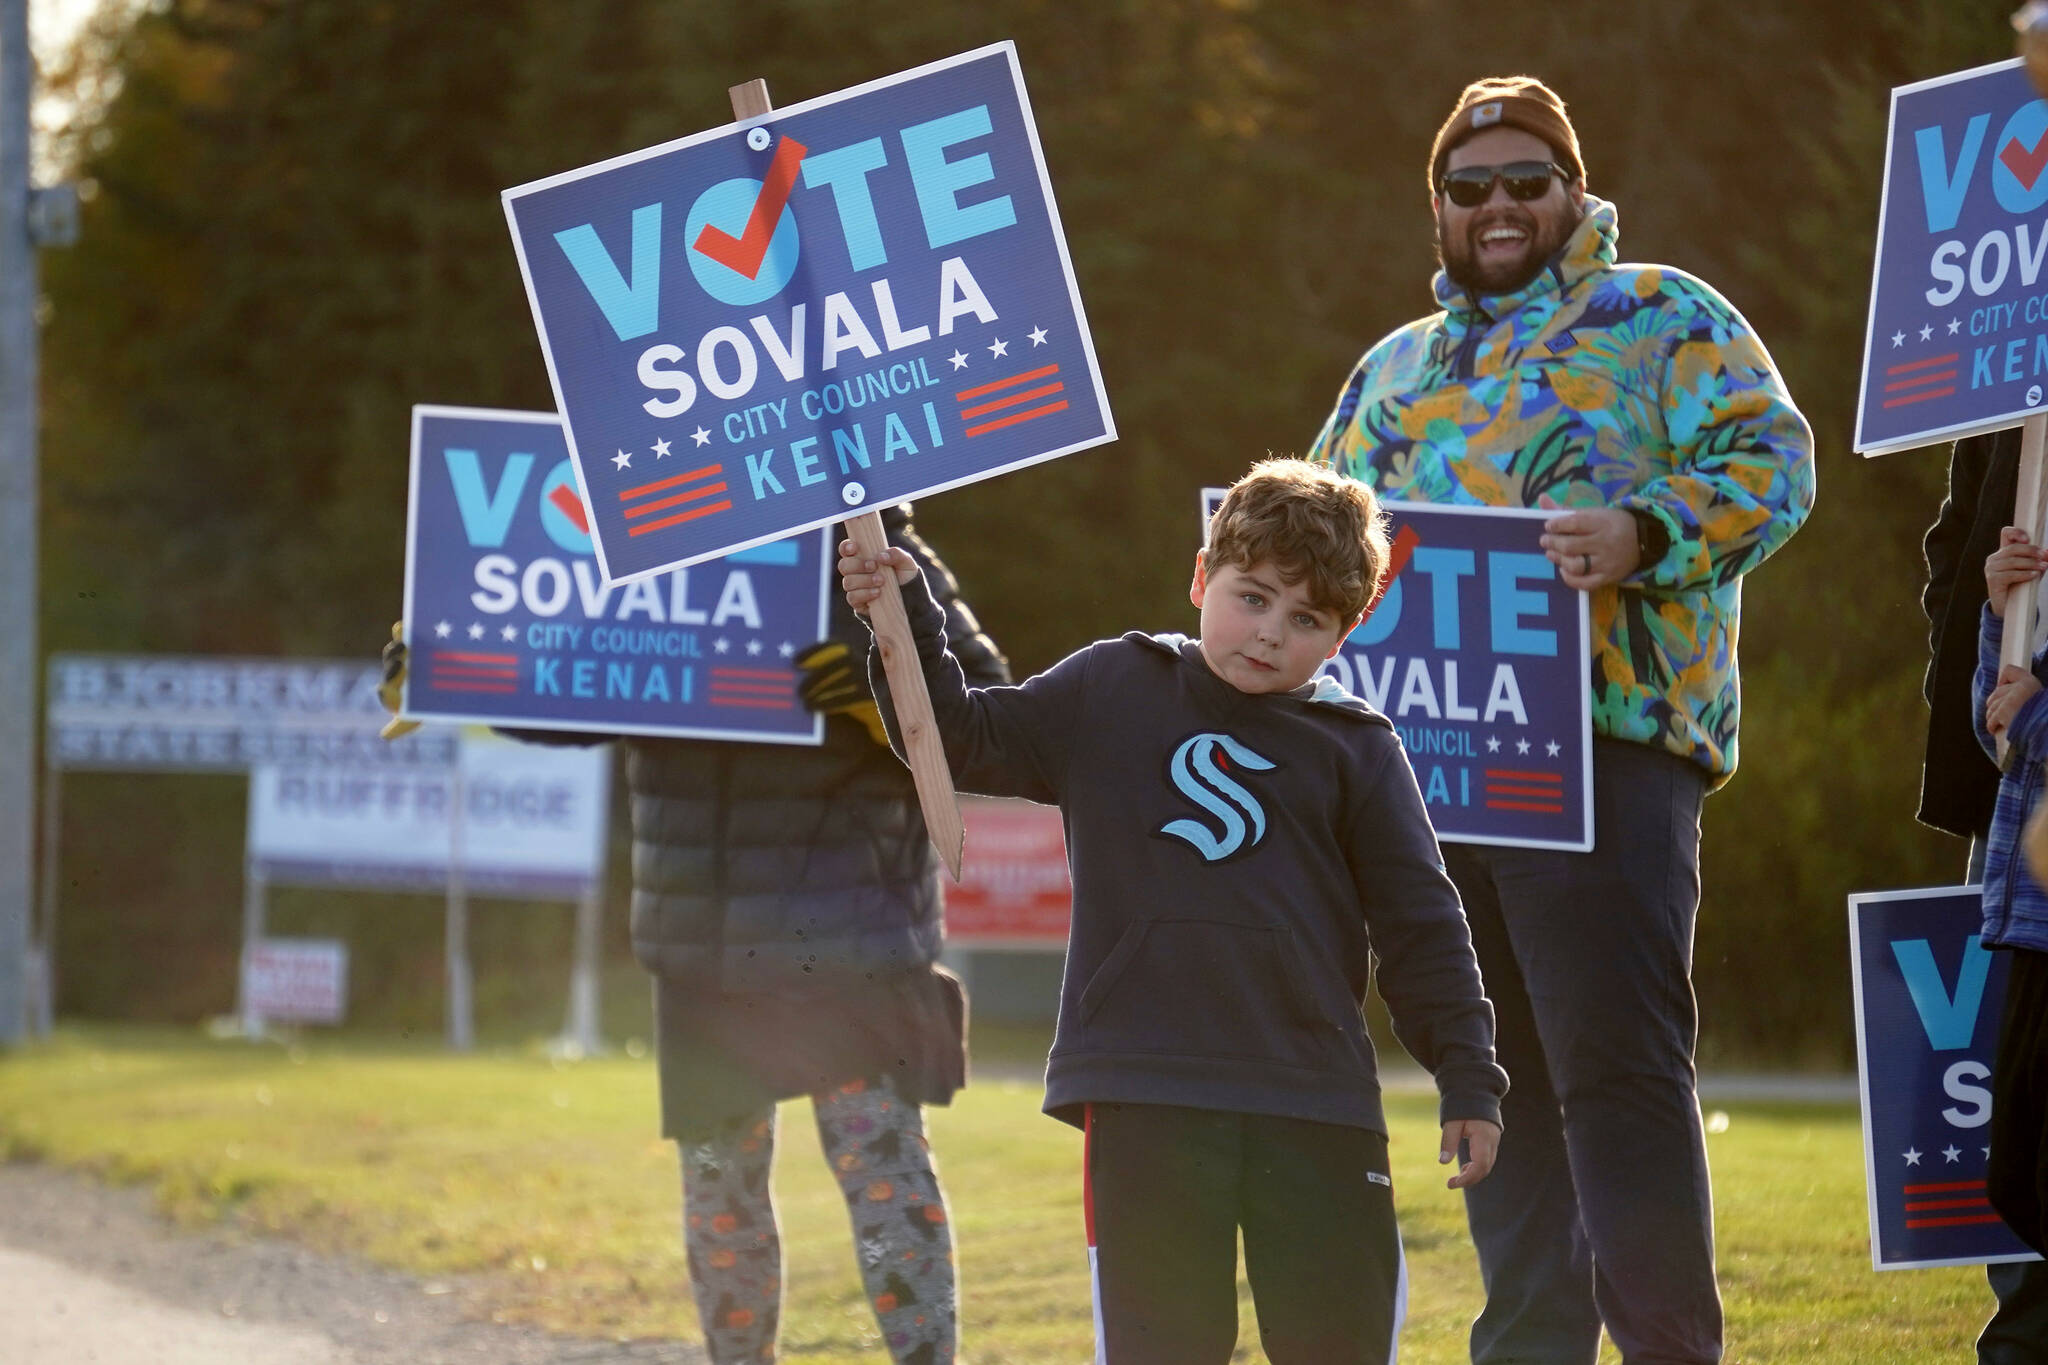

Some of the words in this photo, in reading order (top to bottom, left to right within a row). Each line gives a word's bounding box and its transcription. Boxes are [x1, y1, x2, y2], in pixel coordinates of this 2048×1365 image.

[1914, 100, 2048, 233] VO
[553, 104, 1017, 341] VOTE
[1925, 219, 2048, 306] SOV
[636, 256, 999, 418] SOVALA
[1970, 300, 2018, 336] CITY
[1971, 334, 2048, 389] KEN
[723, 399, 789, 444] CITY
[801, 357, 940, 415] COUNCIL
[745, 401, 944, 500] KENAI
[470, 554, 762, 629] SOVALA
[1346, 547, 1558, 657] OTE
[527, 622, 582, 650] CITY
[592, 627, 703, 658] COUNCIL
[61, 664, 384, 710] BJORKMA
[535, 657, 693, 703] KENAI
[1395, 726, 1477, 757] OUNCIL
[276, 775, 571, 828] RUFFRDGE
